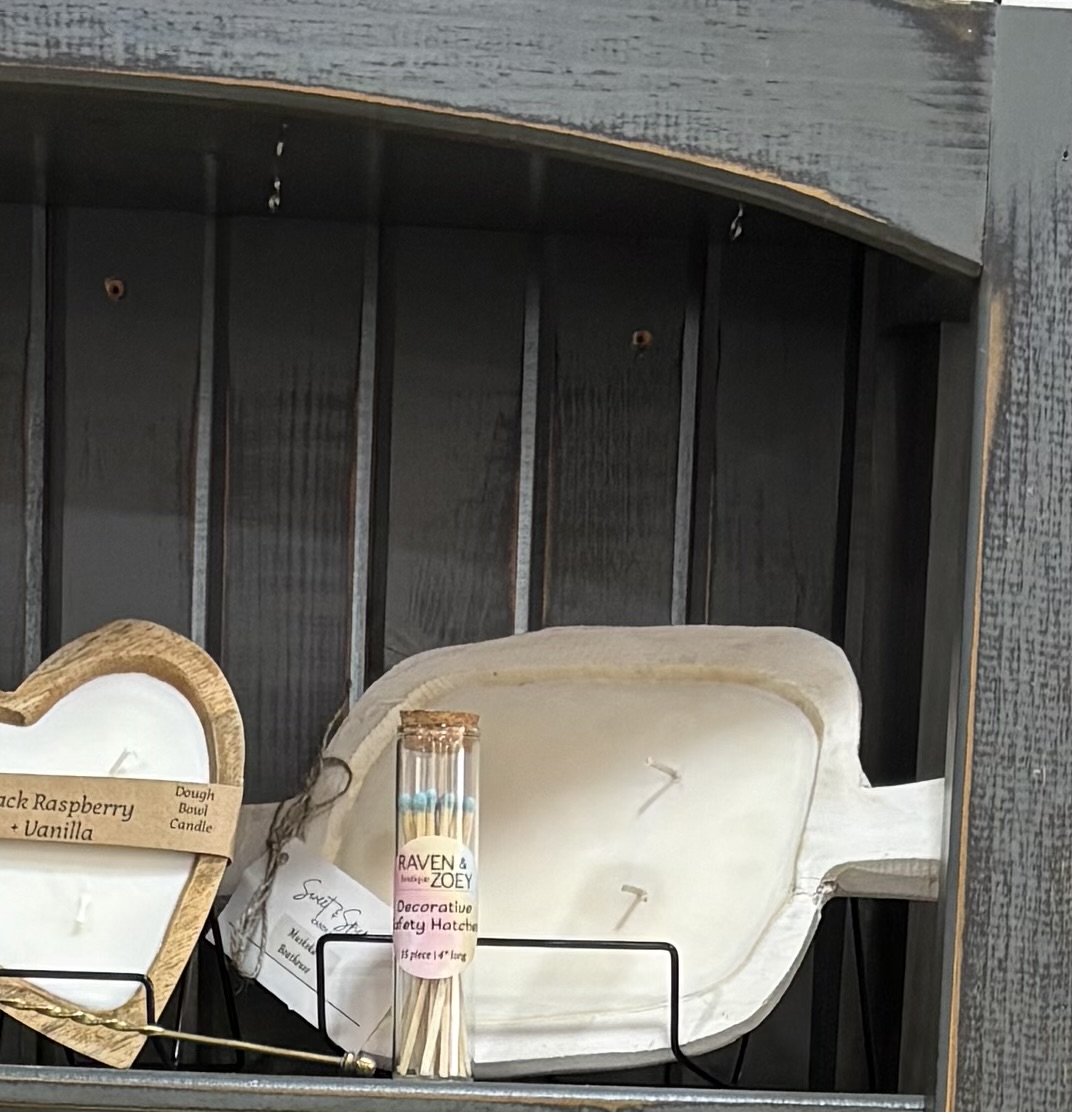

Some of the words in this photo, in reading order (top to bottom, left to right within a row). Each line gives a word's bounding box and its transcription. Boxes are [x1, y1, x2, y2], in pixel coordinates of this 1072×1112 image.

[175, 785, 215, 803] Dough
[32, 795, 135, 821] Raspberry
[178, 802, 209, 817] Bowl
[24, 819, 94, 841] Vanilla
[169, 818, 213, 834] Candle
[398, 854, 455, 871] RAVEN
[430, 872, 473, 889] ZOEY
[397, 899, 473, 914] Decorative
[393, 916, 425, 935] afety
